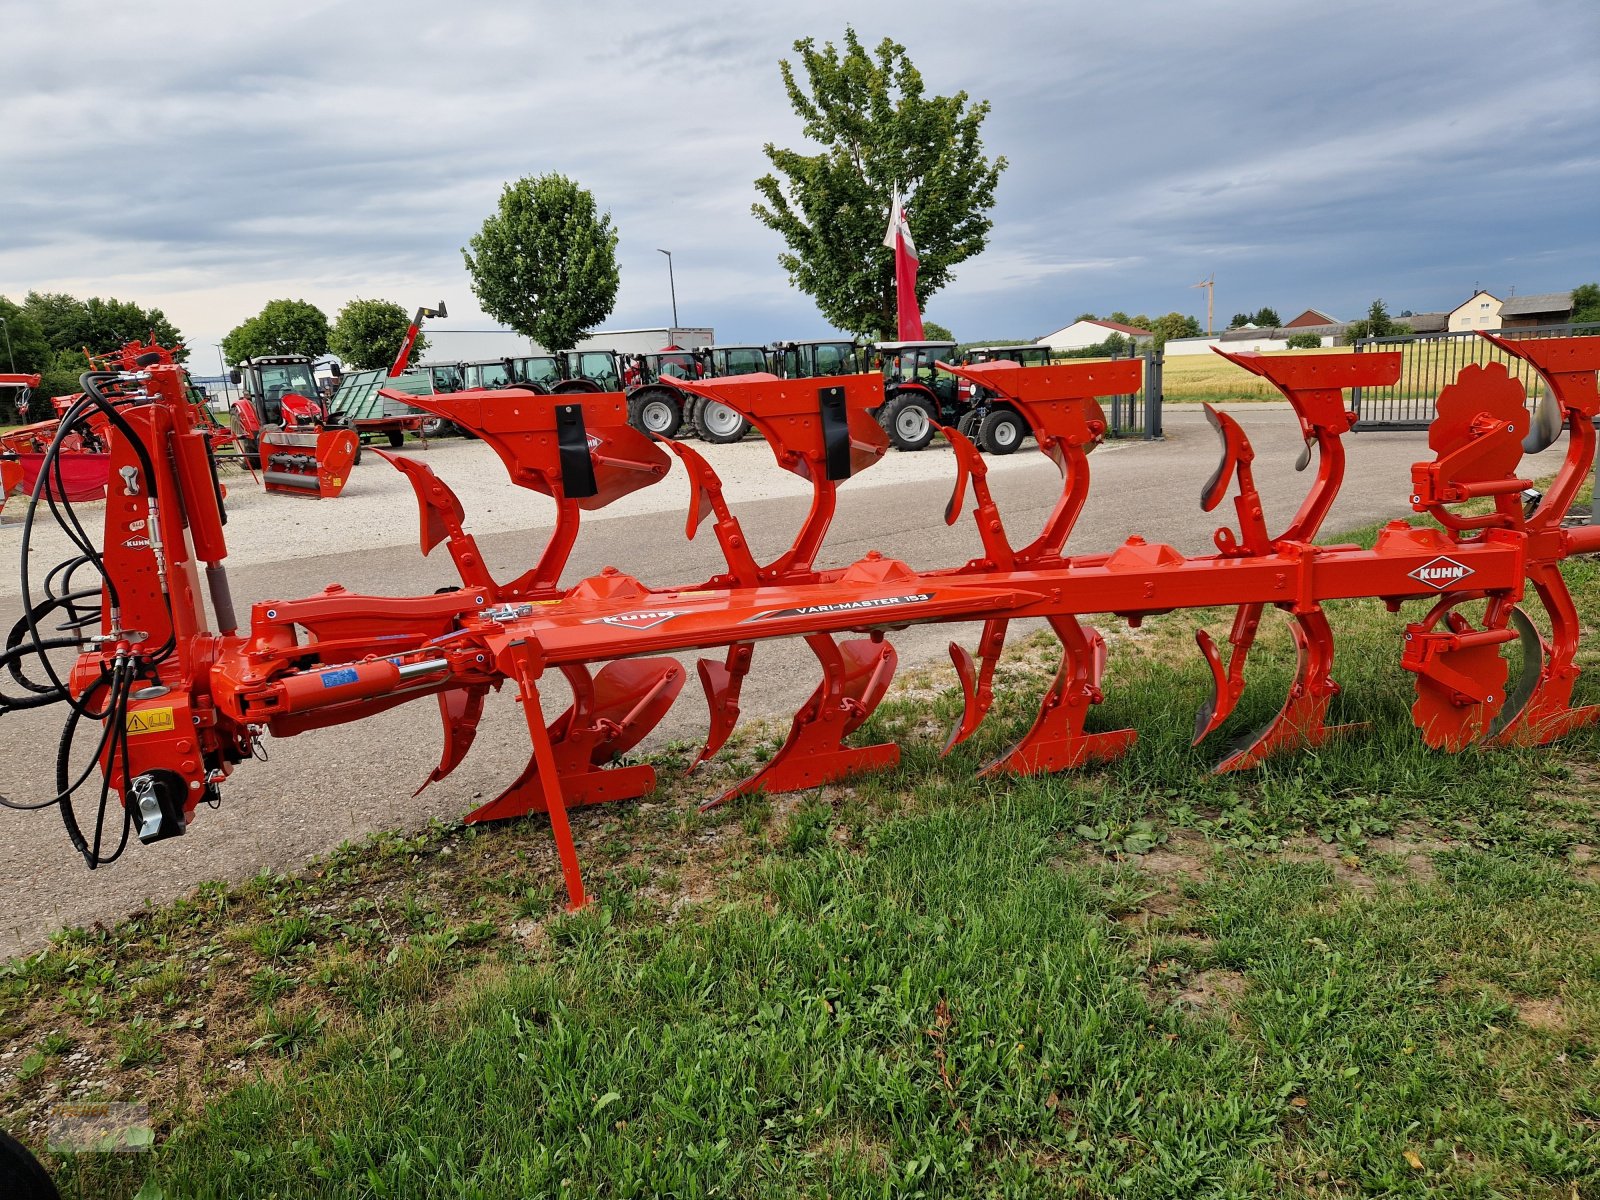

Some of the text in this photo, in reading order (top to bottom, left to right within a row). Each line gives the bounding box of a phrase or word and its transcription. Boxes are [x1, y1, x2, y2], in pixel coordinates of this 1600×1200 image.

[1420, 567, 1463, 580] KUHN
[796, 594, 929, 614] VARI-MASTER 153
[602, 611, 675, 624] KUHN
